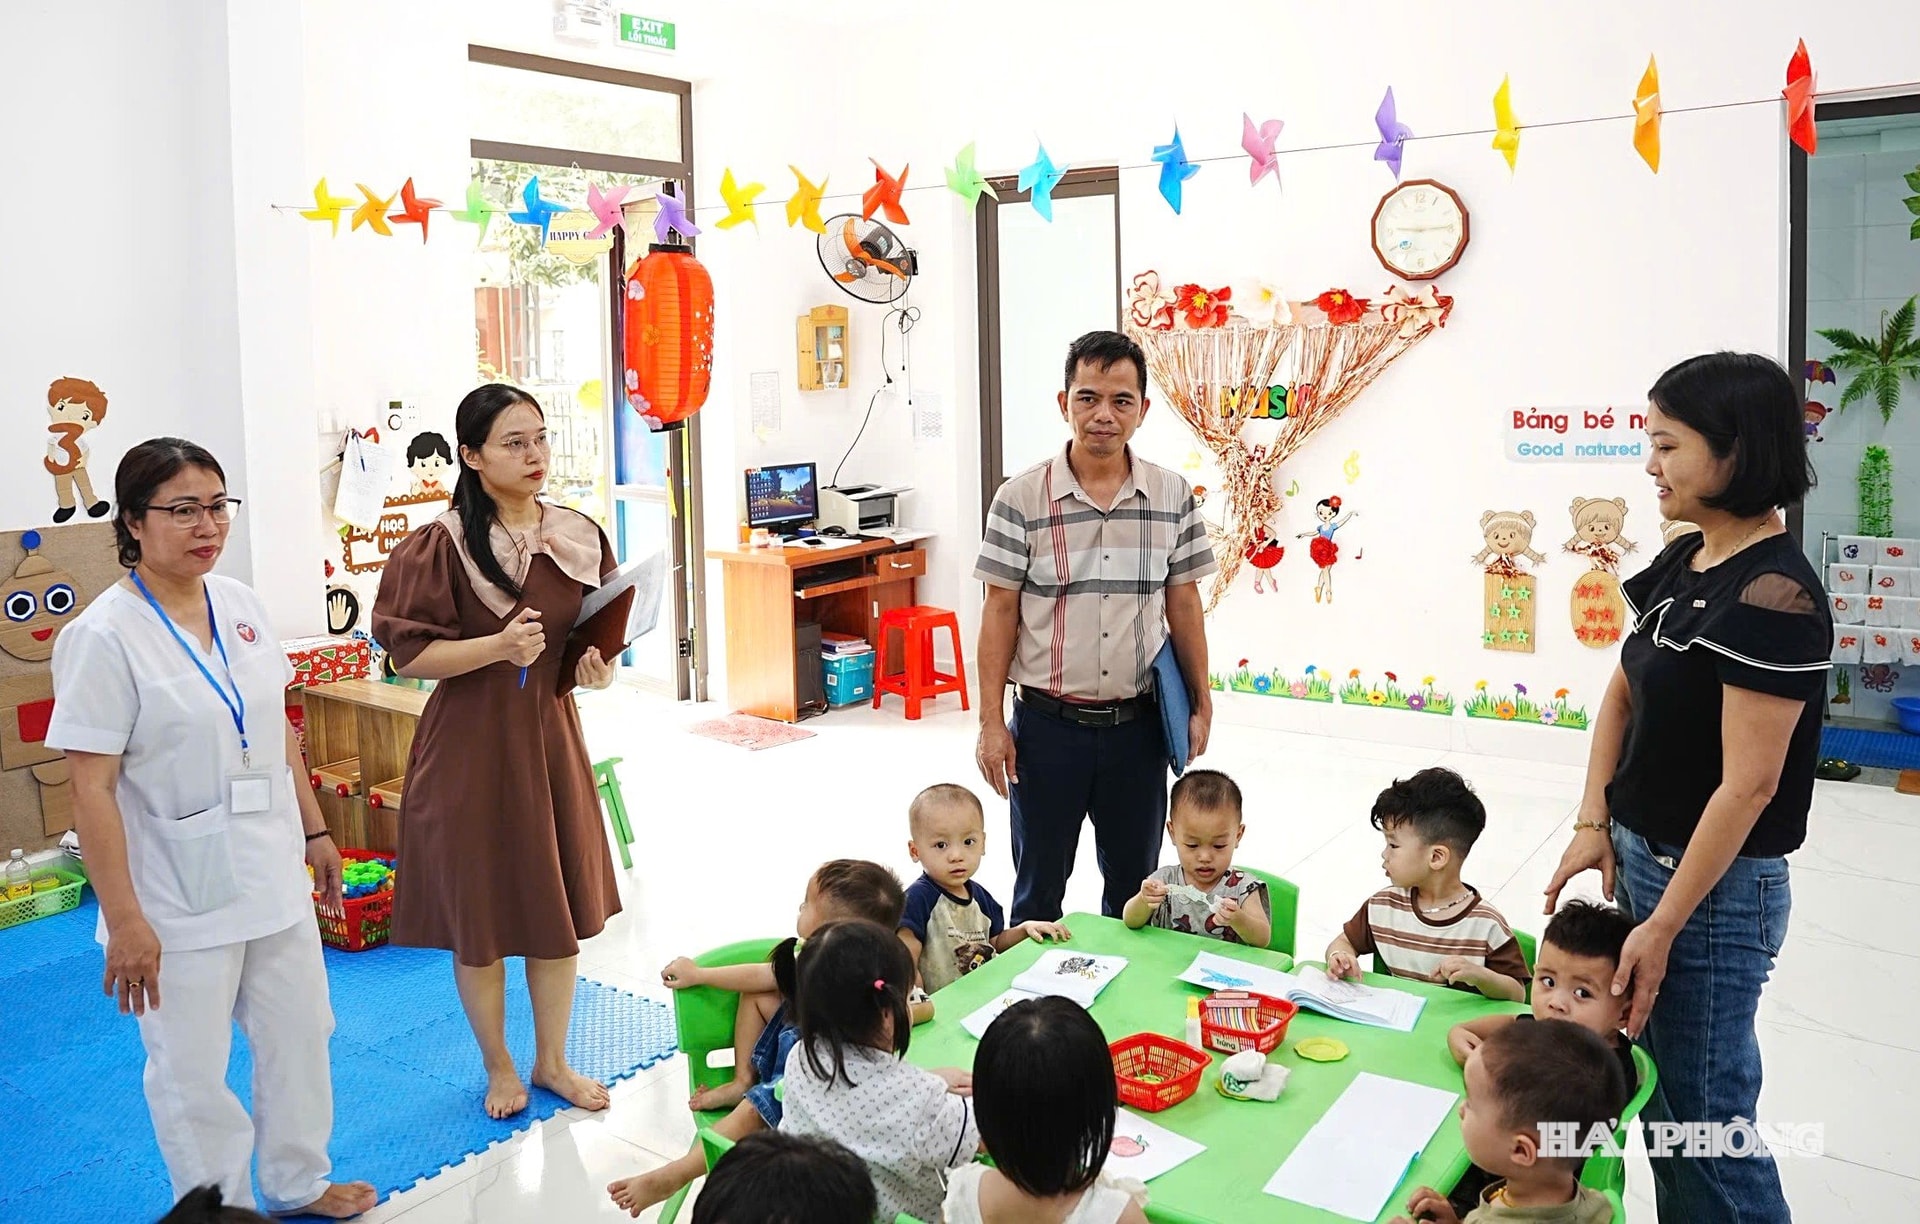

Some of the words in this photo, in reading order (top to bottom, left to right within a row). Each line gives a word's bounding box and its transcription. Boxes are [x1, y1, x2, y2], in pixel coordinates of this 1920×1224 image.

[631, 17, 664, 34] EXIT
[549, 231, 581, 241] HAPPY
[1513, 407, 1569, 434] Bảng
[1584, 407, 1614, 429] bé
[1629, 413, 1647, 429] n
[44, 422, 84, 475] 3
[1517, 442, 1563, 457] Good
[1575, 441, 1641, 457] natured
